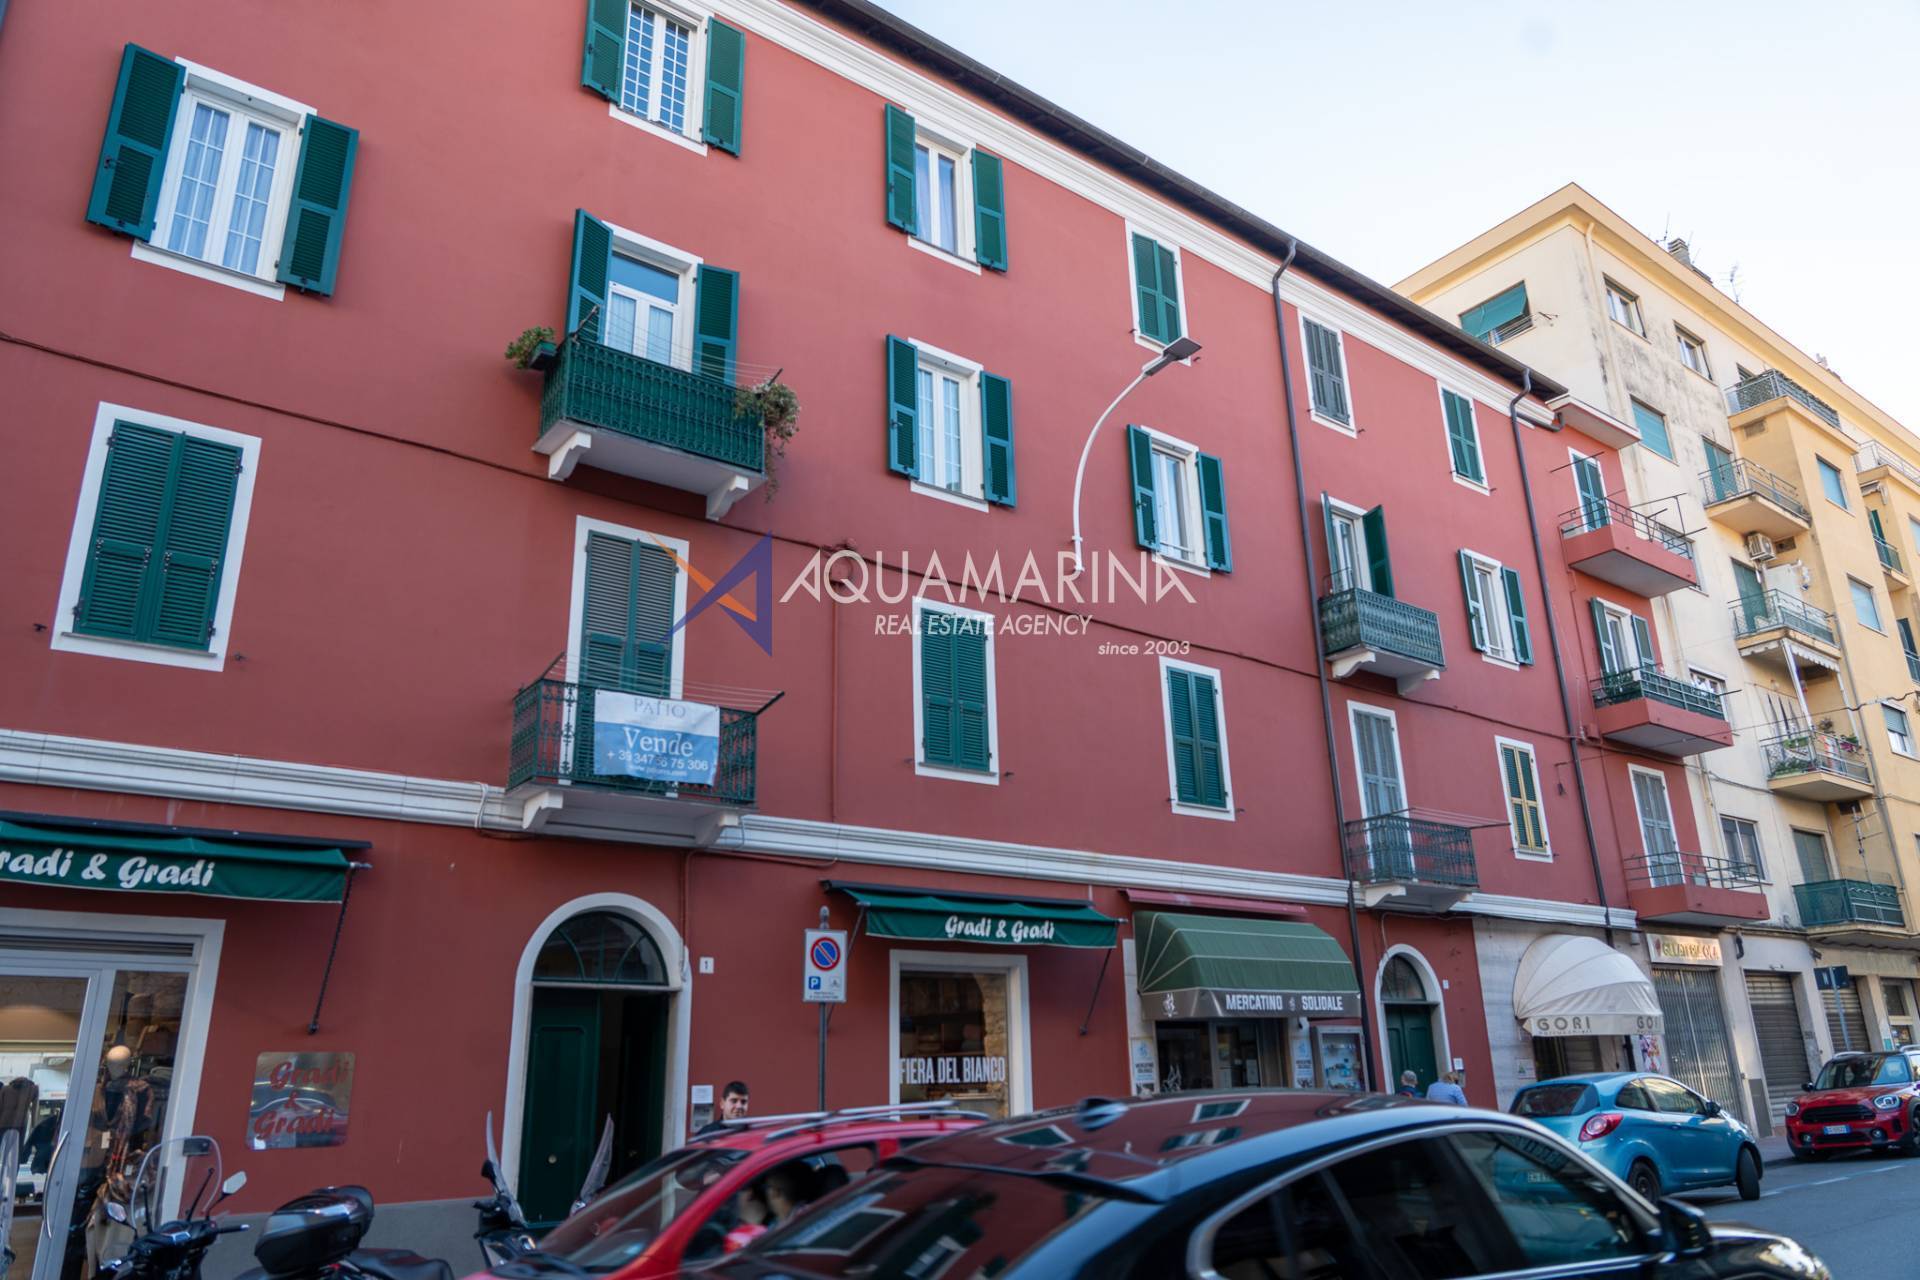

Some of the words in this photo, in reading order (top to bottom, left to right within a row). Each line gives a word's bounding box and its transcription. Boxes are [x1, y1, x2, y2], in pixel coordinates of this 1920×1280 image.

[623, 727, 693, 758] Vende
[633, 752, 655, 765] 347
[0, 848, 74, 878] radi
[81, 853, 108, 880] &
[118, 855, 216, 889] Gradi
[945, 915, 992, 938] Gradi
[995, 919, 1007, 939] &
[1011, 920, 1055, 943] Gradi
[1225, 994, 1284, 1011] MERCATINO
[1301, 995, 1345, 1011] SOLIDALE
[1536, 1016, 1591, 1031] GORI
[270, 1059, 350, 1090] Gradi
[899, 1056, 935, 1084] FIERA
[937, 1056, 961, 1083] DEL
[962, 1056, 1006, 1082] BIANCO
[253, 1107, 335, 1140] Gradi
